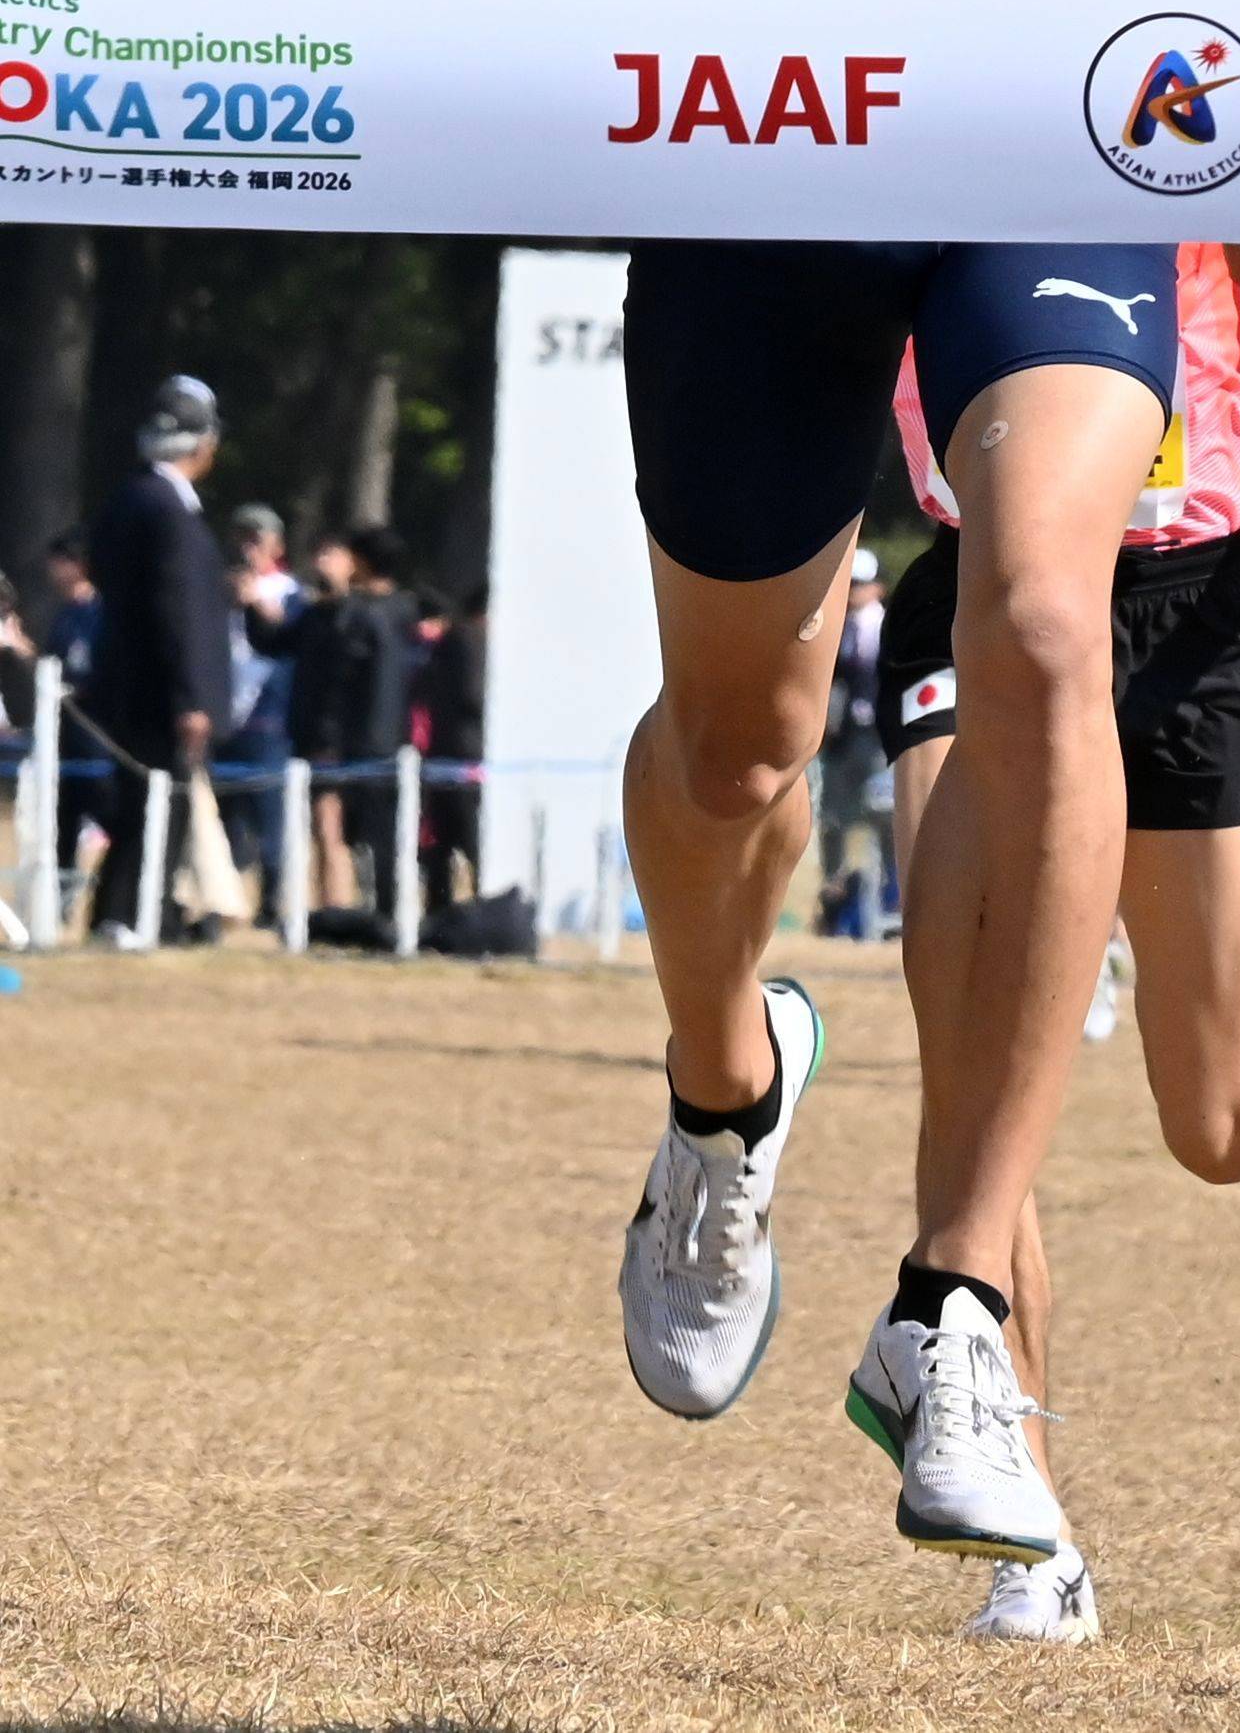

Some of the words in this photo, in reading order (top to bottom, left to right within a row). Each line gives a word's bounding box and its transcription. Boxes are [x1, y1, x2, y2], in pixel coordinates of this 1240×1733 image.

[0, 19, 52, 55] try
[64, 26, 354, 72] Championships
[0, 61, 161, 140] OKA
[182, 81, 355, 143] 2026
[607, 52, 907, 146] JAAF
[0, 164, 240, 190] スカントリー選手権大会
[1107, 144, 1157, 182] ASIAN
[536, 316, 624, 366] STA
